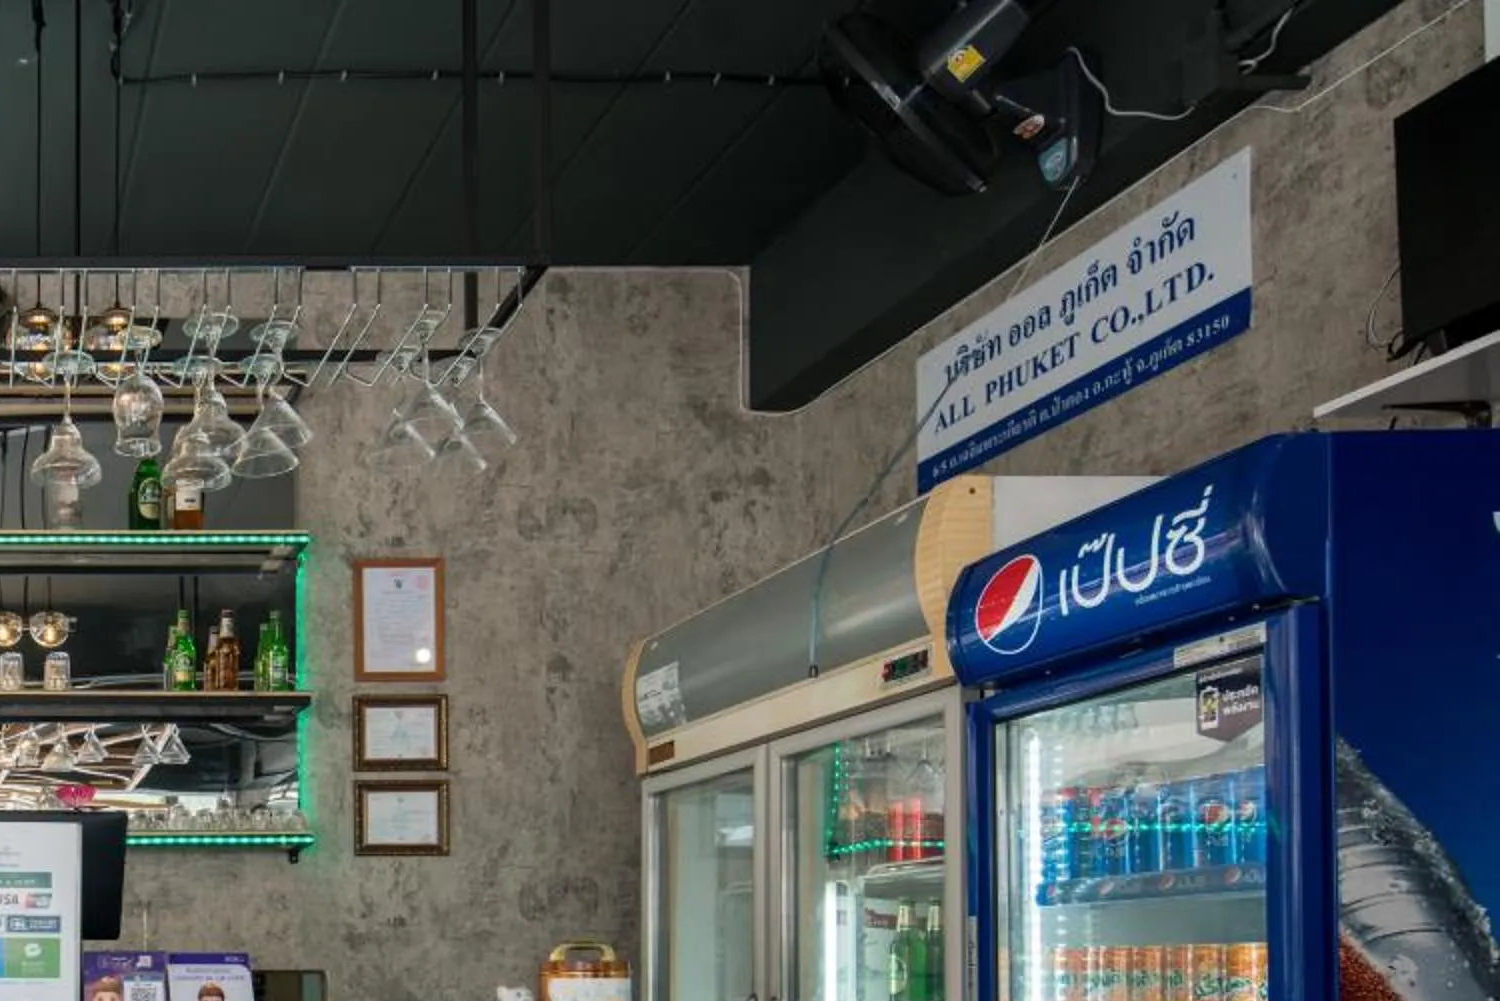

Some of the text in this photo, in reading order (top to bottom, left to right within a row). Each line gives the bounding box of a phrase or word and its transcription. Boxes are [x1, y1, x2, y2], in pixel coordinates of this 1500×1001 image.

[933, 260, 1215, 435] ALL PHUKET CO.,LTD.
[944, 210, 1196, 382] บริษัท ออล ภูเก็ต จำกัด
